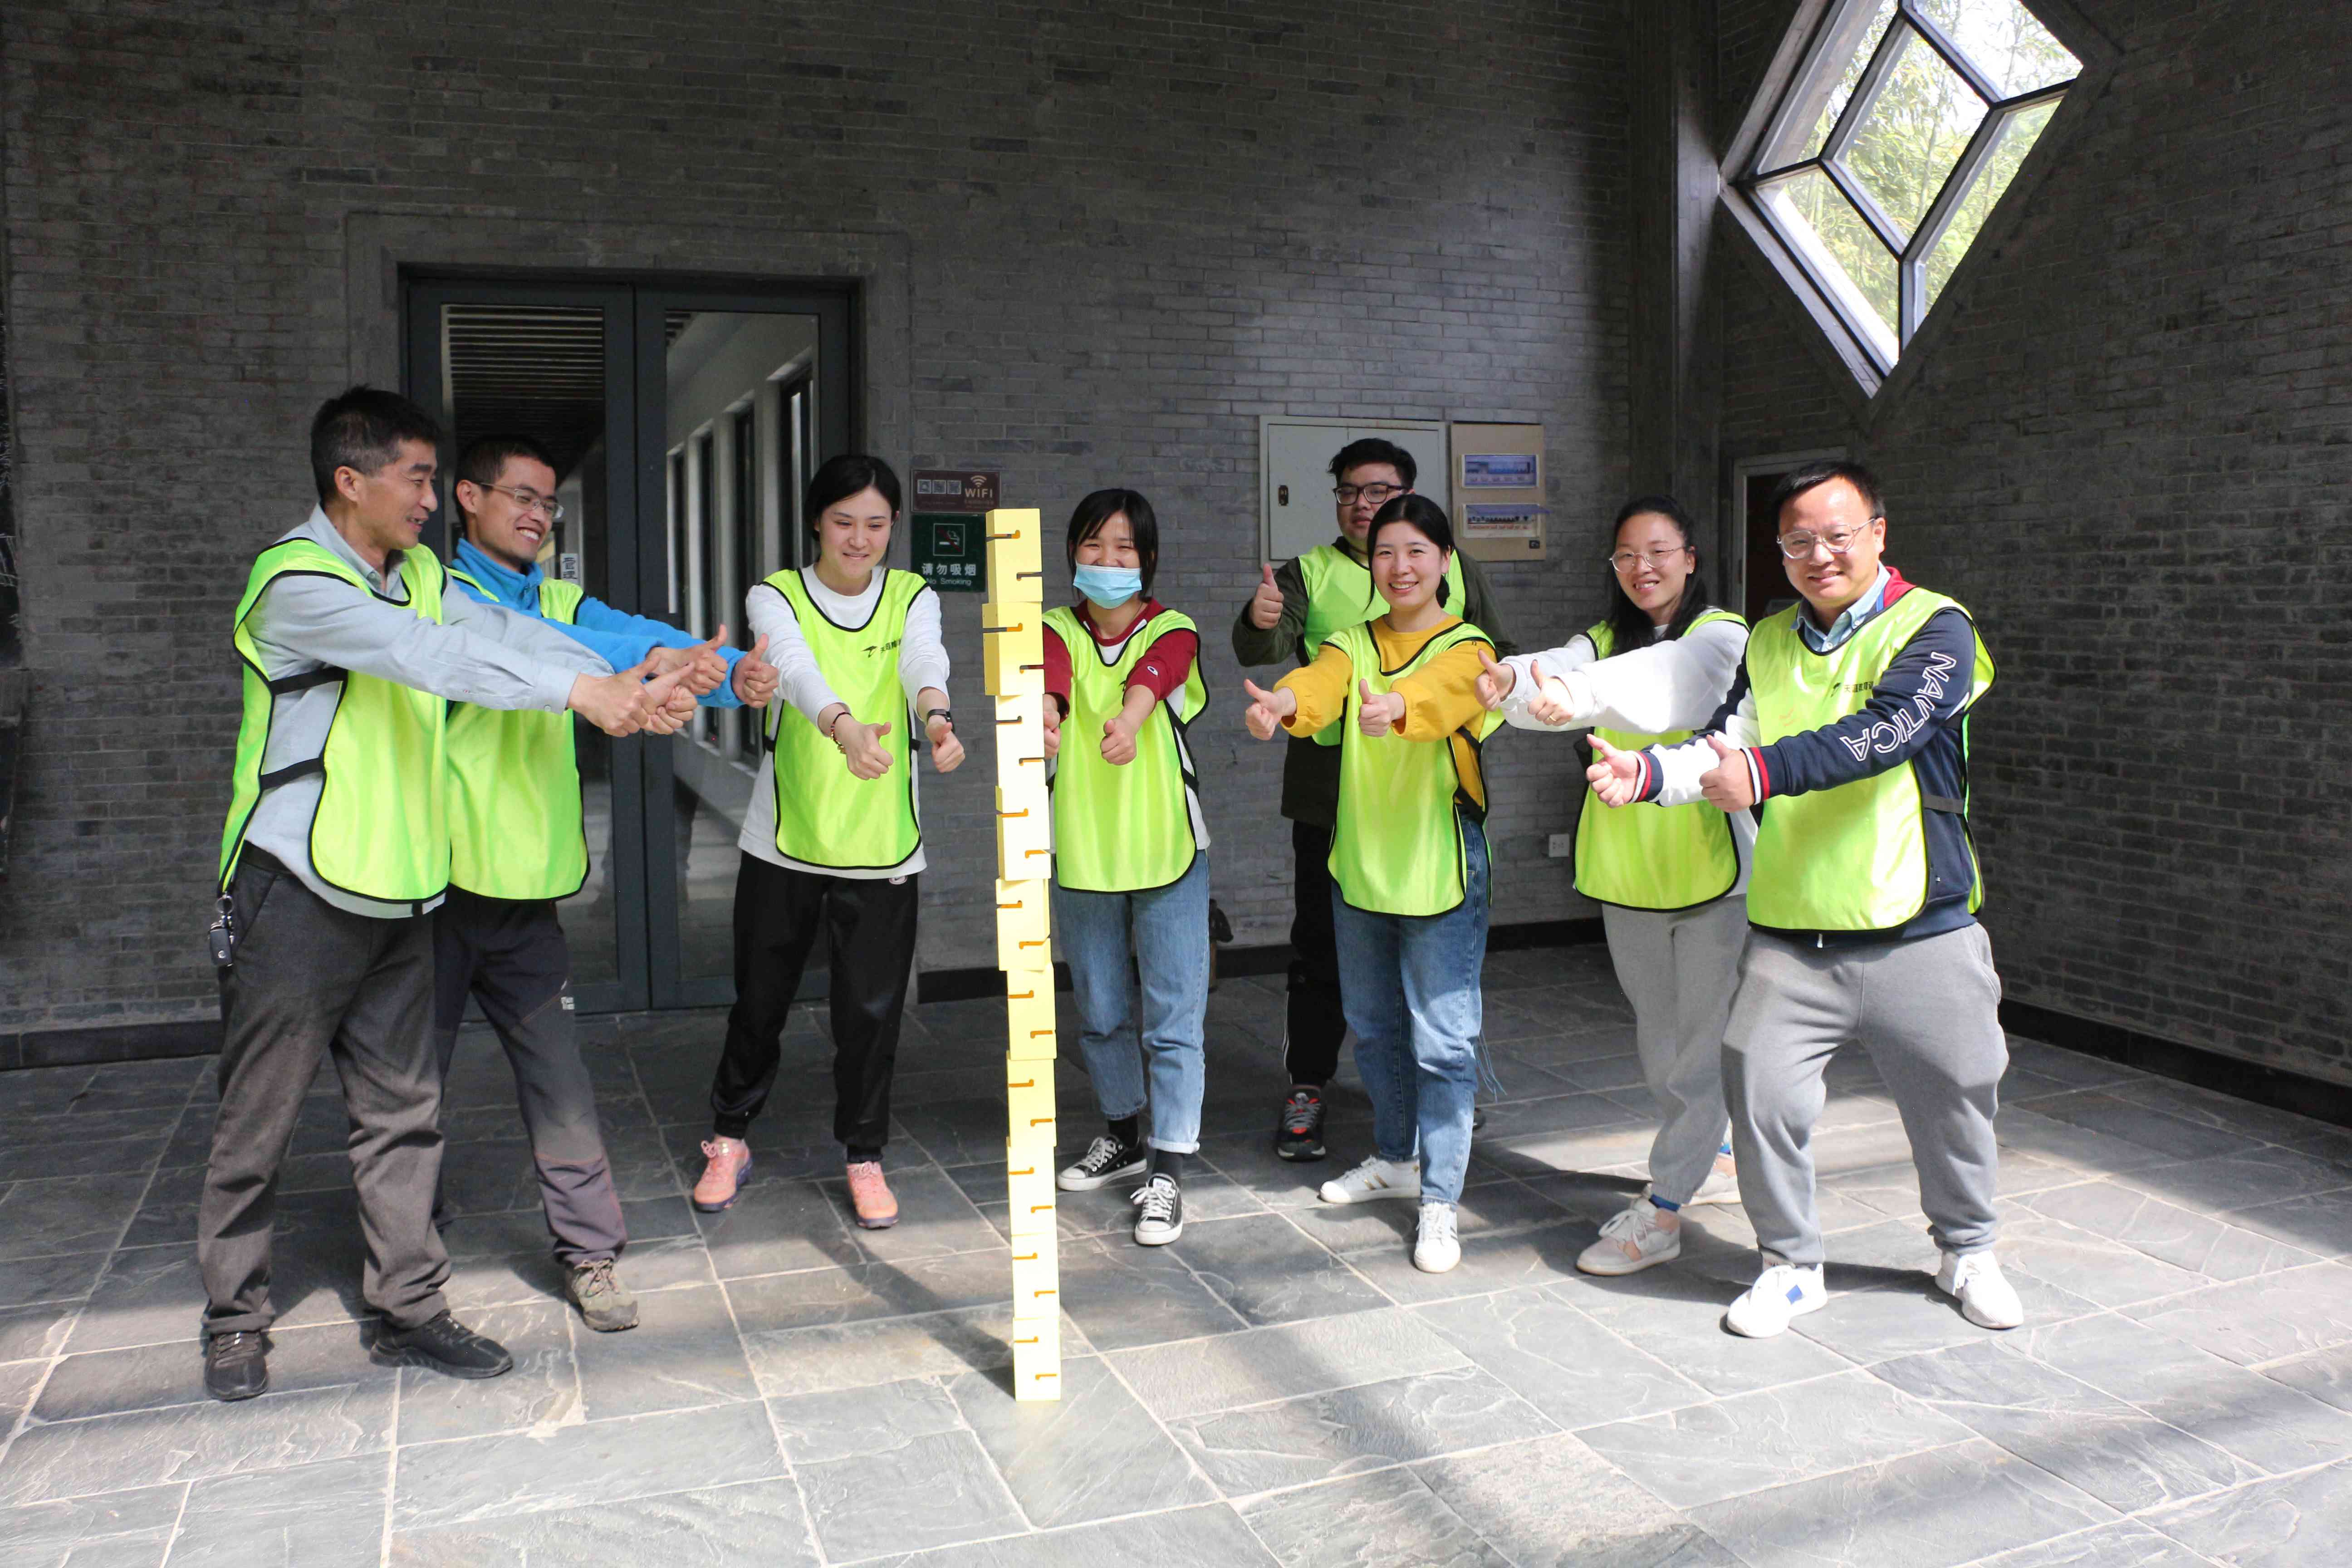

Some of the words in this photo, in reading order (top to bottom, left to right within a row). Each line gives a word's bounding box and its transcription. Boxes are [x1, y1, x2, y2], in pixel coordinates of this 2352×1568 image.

[965, 488, 993, 498] WIFI
[922, 563, 976, 576] 请勿吸烟
[1839, 652, 1956, 761] NAUTICA
